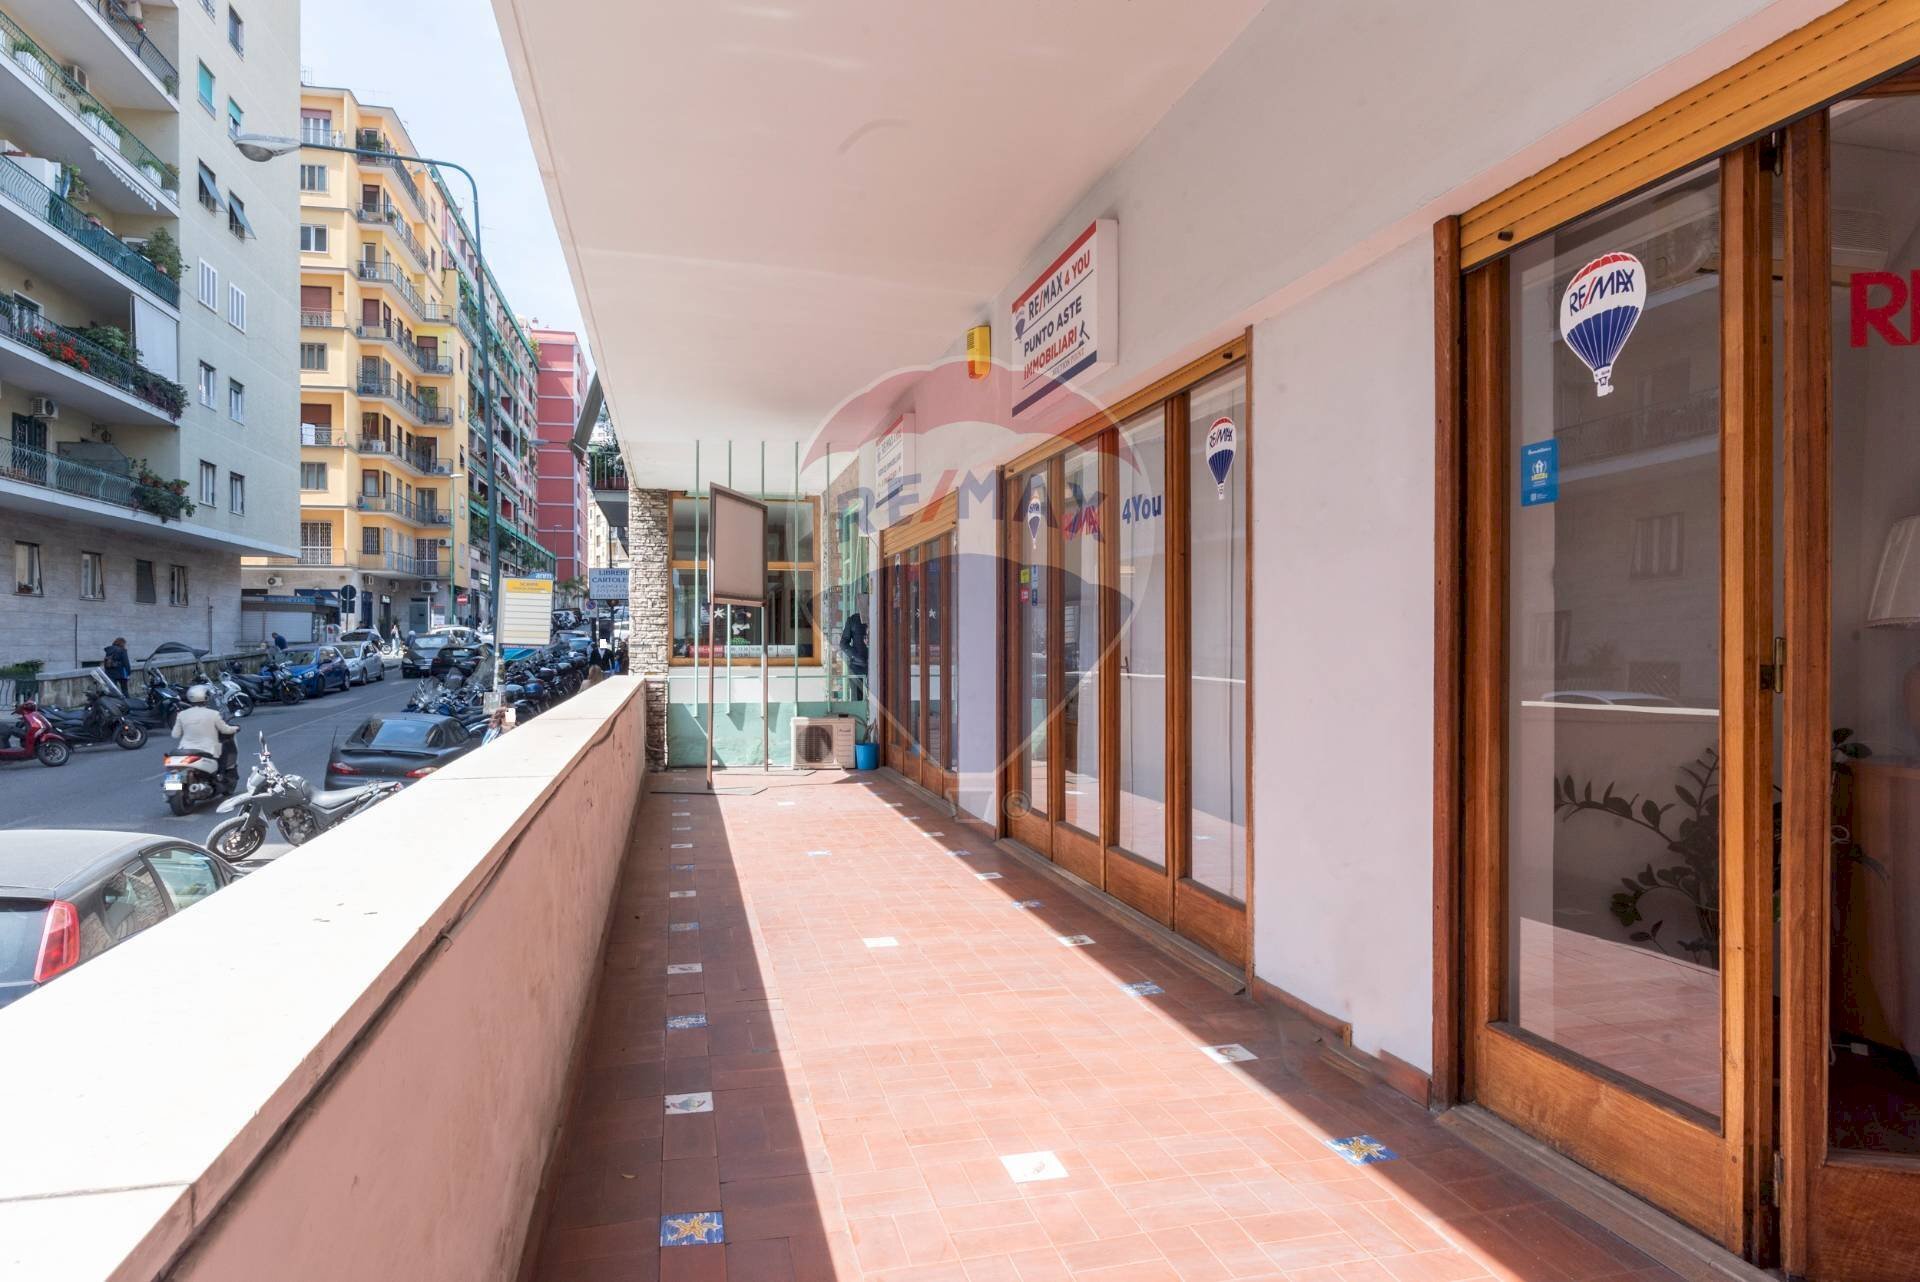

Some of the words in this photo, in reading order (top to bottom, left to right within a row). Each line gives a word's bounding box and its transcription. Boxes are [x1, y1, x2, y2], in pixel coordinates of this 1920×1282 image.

[1028, 271, 1063, 321] RE/MAX
[1064, 273, 1070, 287] 4
[1071, 249, 1090, 281] YOU
[1567, 267, 1635, 318] RE/MAX
[1849, 267, 1920, 348] R
[1024, 319, 1055, 357] PUNTO
[1056, 295, 1083, 333] ASTE
[1024, 325, 1078, 381] IMMOBILIARI
